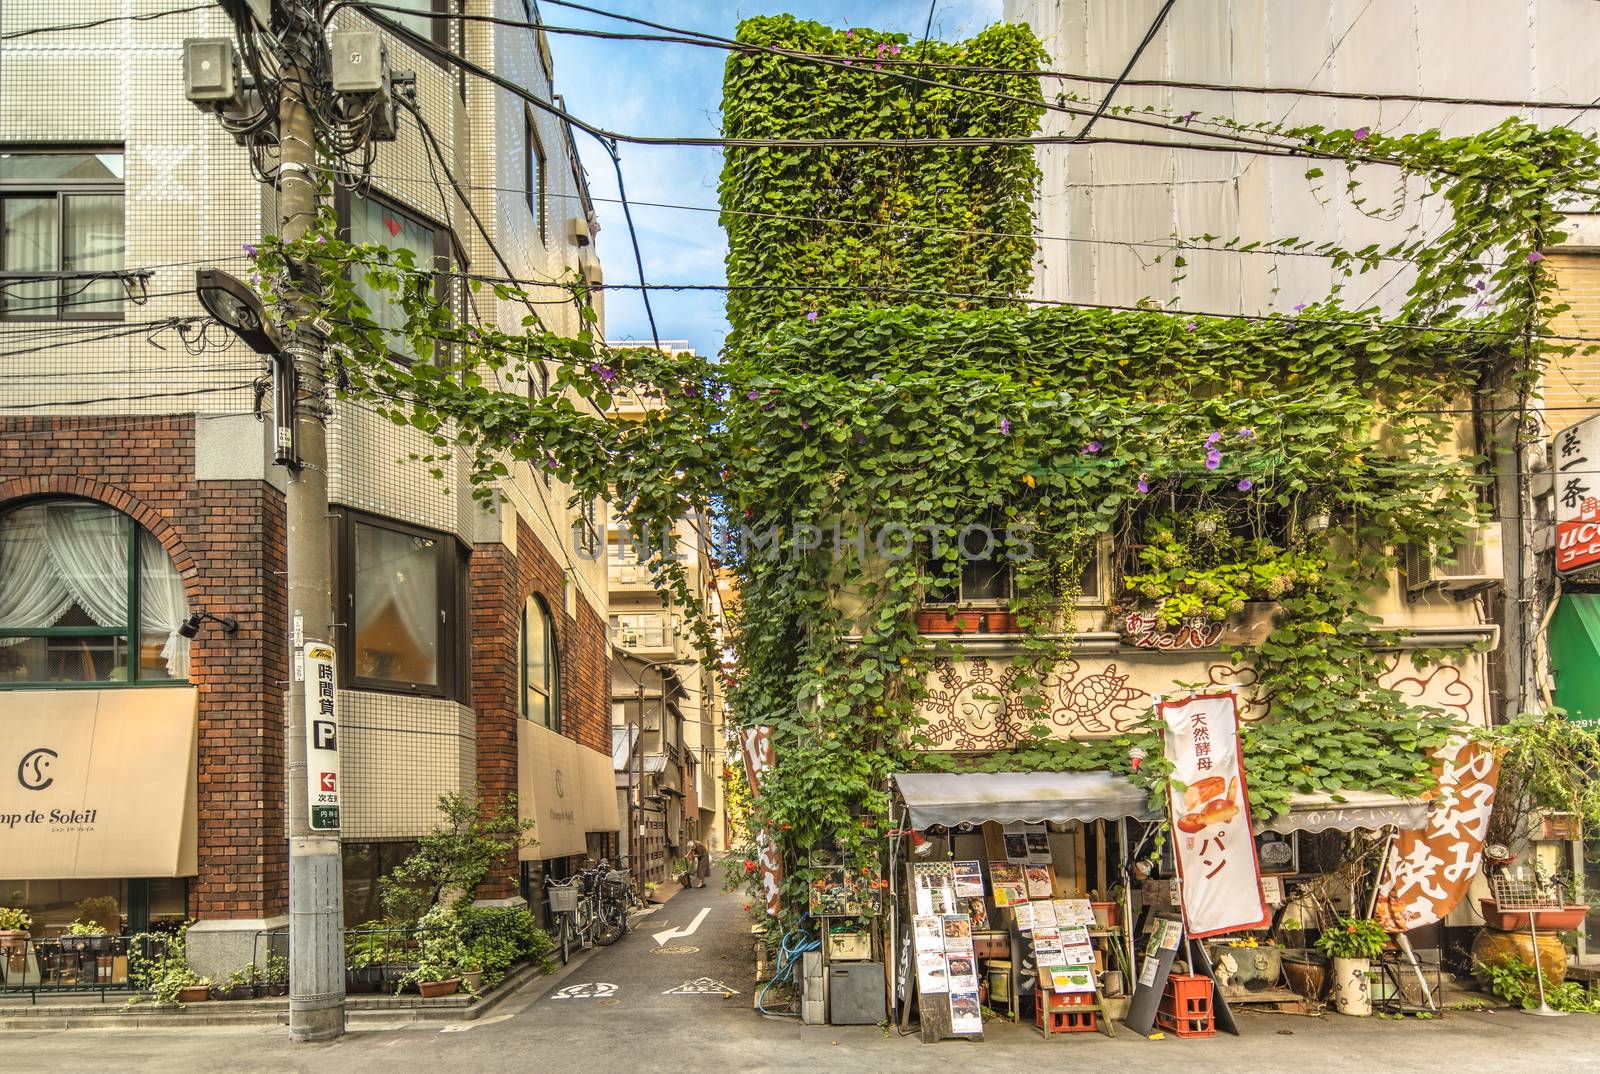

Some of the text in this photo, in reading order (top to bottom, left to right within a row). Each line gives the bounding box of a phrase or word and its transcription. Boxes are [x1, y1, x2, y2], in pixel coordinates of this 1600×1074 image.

[1190, 712, 1213, 771] 天然酵母
[24, 810, 44, 824] de
[49, 809, 97, 825] Soleil
[1199, 830, 1226, 880] パン
